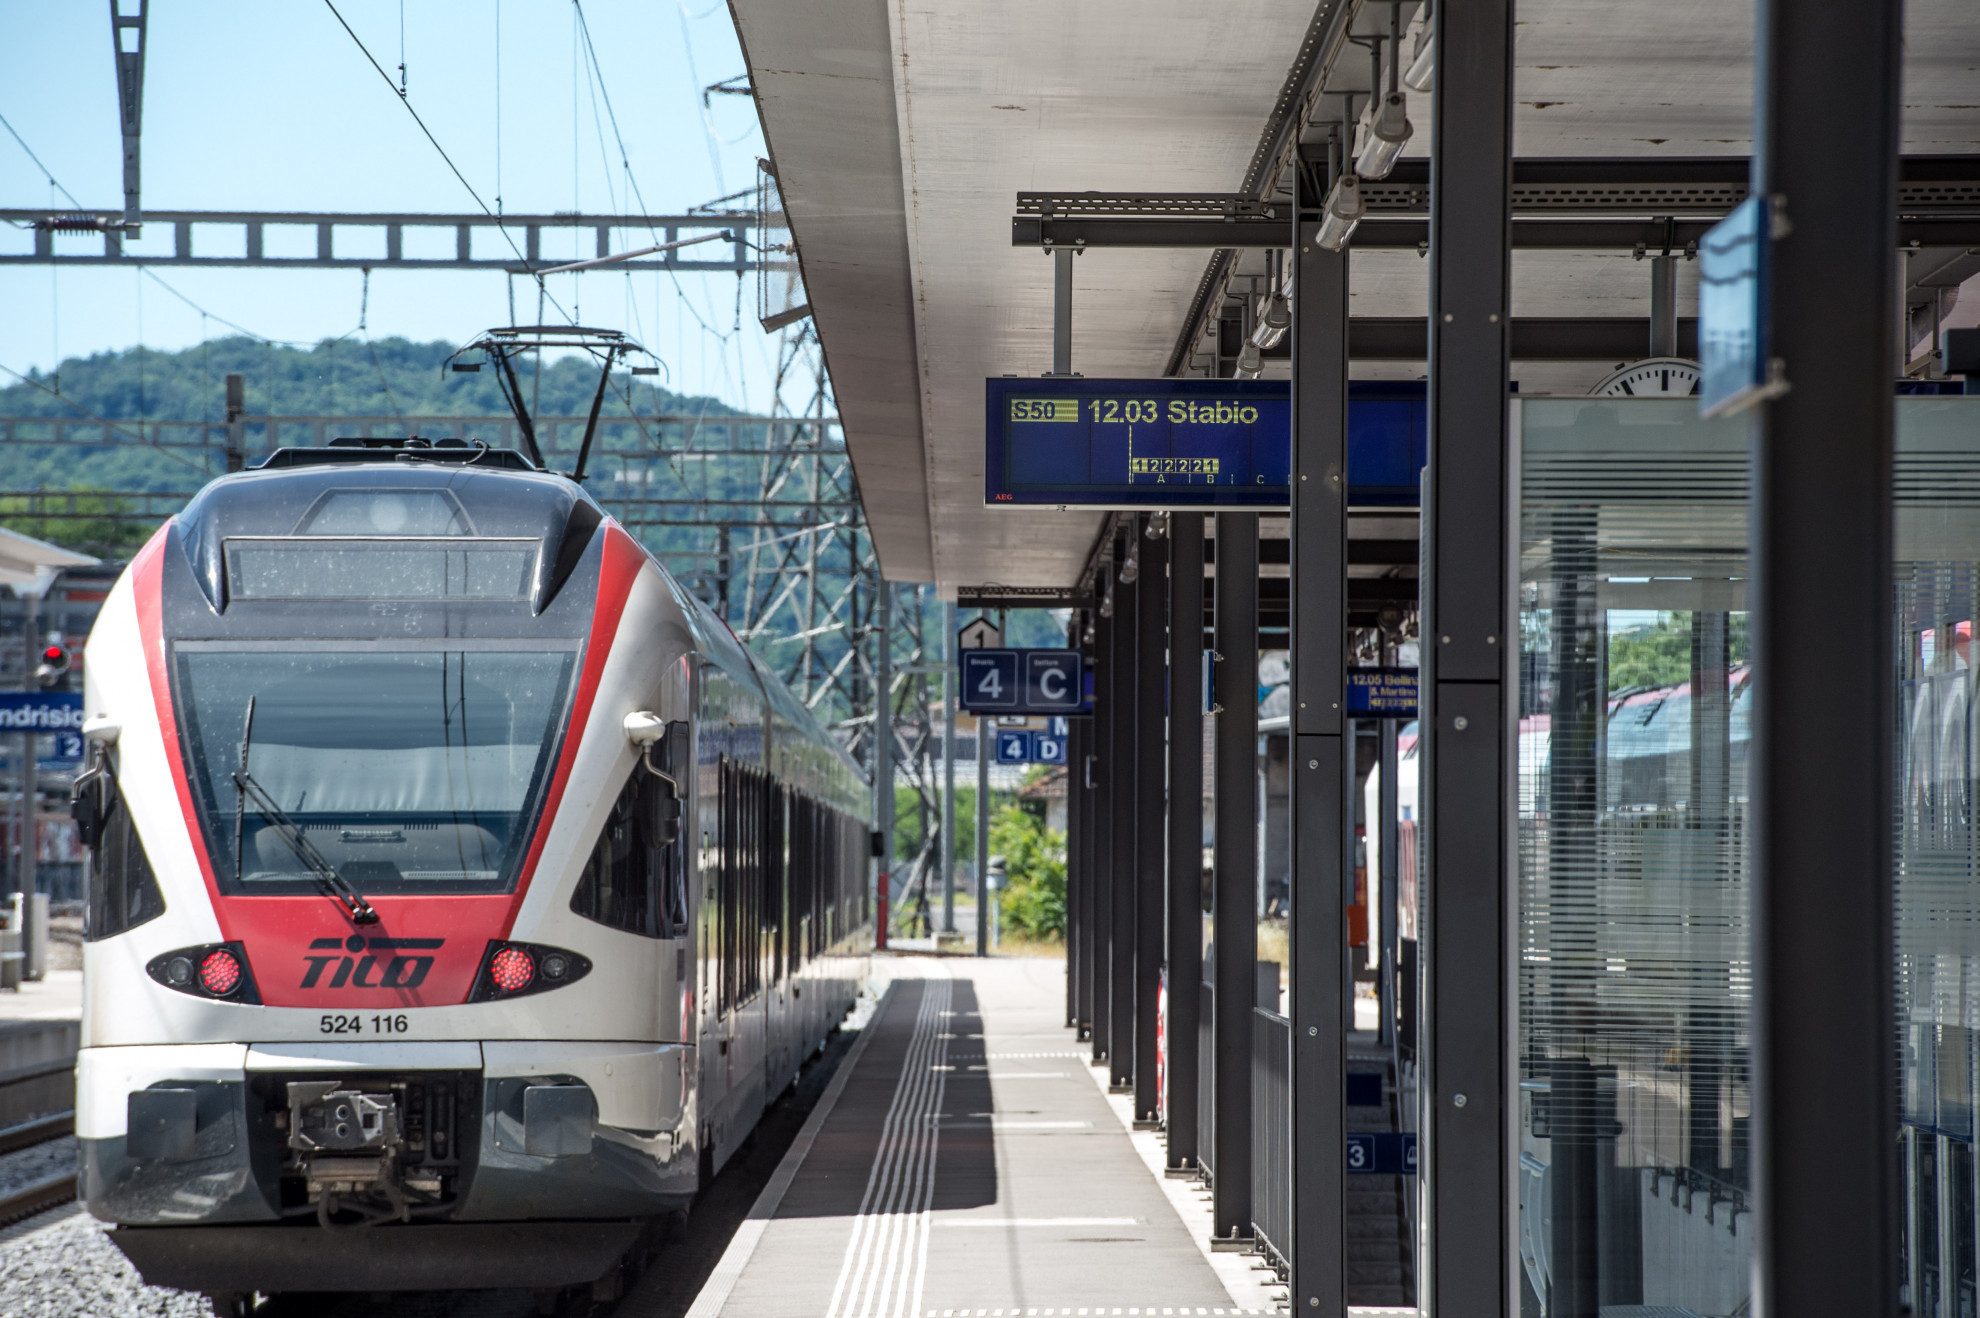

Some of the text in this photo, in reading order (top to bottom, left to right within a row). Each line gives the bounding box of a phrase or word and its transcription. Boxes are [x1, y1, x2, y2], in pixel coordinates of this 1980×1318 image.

[1013, 399, 1259, 425] S50 12.03 Stabio
[995, 493, 1013, 501] AEG
[978, 669, 1003, 698] 4
[1041, 668, 1066, 699] C
[1352, 675, 1382, 685] 12.05
[65, 738, 81, 756] 2
[1007, 740, 1023, 758] 4
[1041, 741, 1058, 759] D
[320, 1014, 409, 1034] 524 116
[1349, 1145, 1365, 1166] 3
